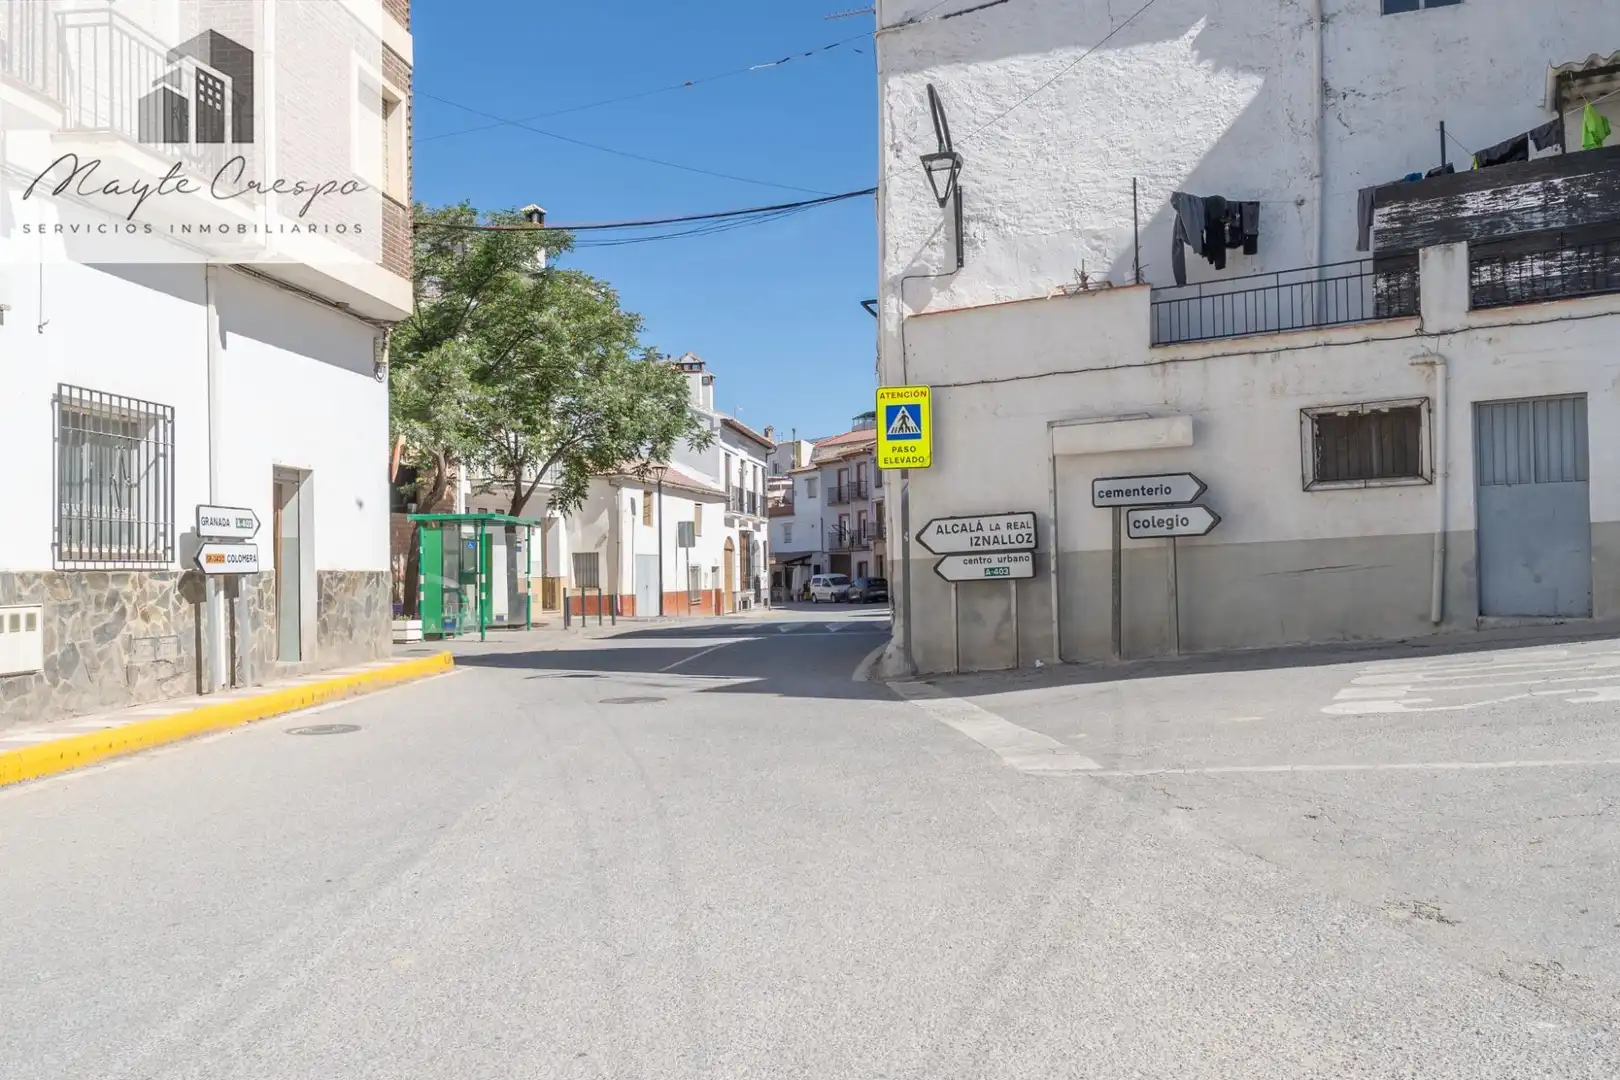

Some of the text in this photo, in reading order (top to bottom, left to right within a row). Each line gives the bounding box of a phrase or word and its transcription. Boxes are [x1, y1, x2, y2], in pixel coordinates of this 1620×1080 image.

[880, 390, 927, 400] ATENCIÓN
[891, 445, 917, 454] PASO
[884, 456, 925, 465] ELEVADO
[1097, 484, 1172, 499] cementerio
[201, 516, 230, 527] GRANADA
[1133, 514, 1190, 530] colegio
[936, 520, 1032, 535] ALCALÁ LA REAL
[970, 533, 1033, 547] IZNALLOZ
[226, 554, 257, 564] COLOMERA
[962, 554, 1031, 565] centro urbano
[984, 567, 1010, 576] A-403
